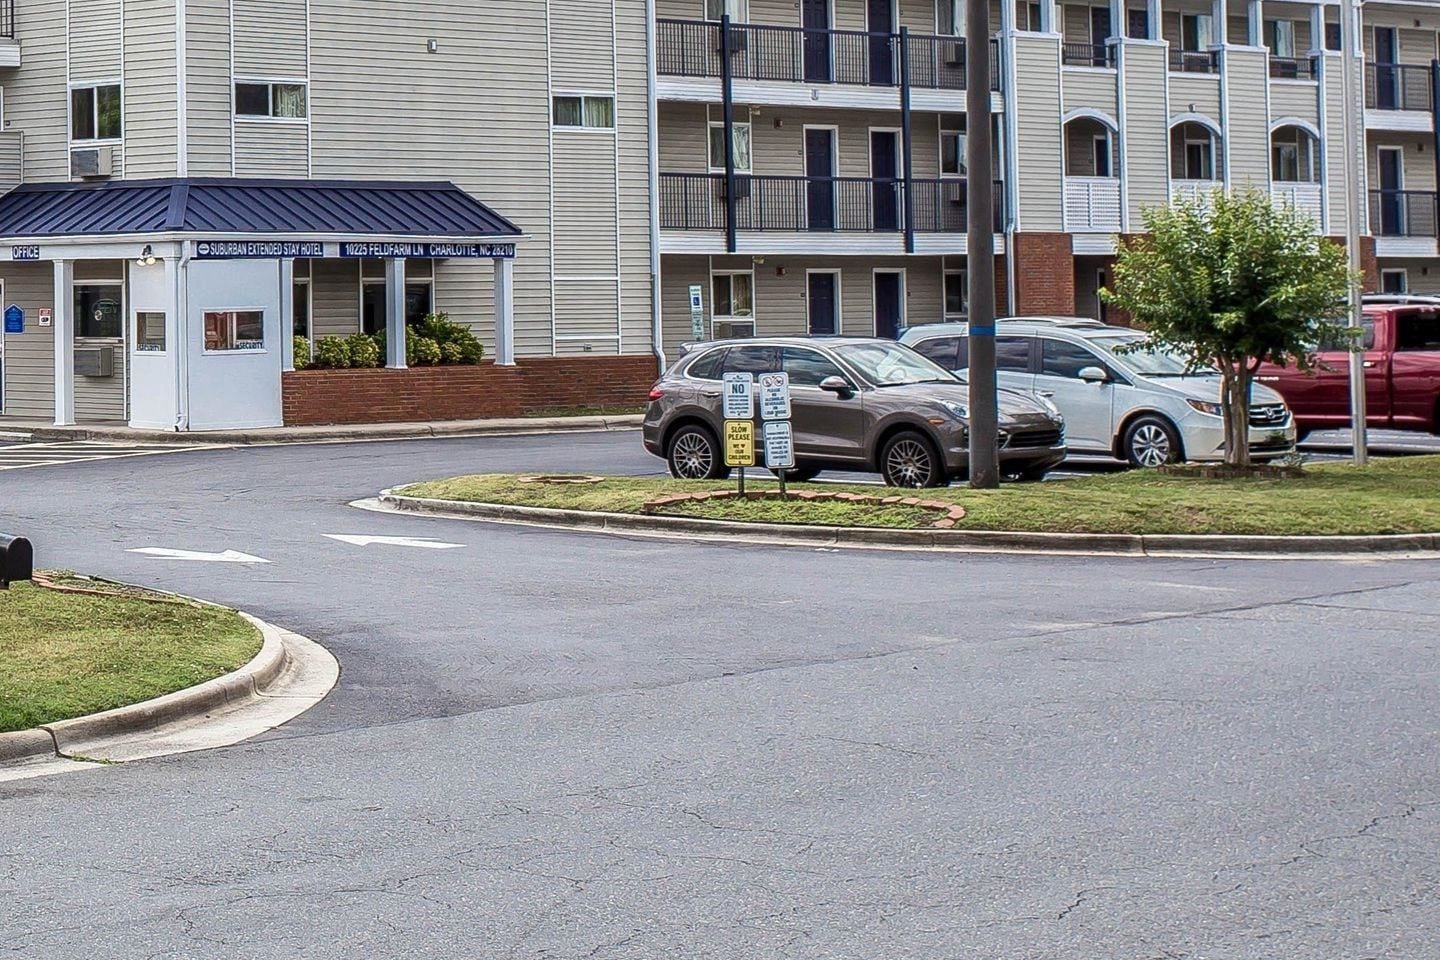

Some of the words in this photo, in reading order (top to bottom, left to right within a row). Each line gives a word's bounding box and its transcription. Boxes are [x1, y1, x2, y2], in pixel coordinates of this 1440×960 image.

[13, 246, 39, 258] OFFICE
[209, 242, 247, 256] SUBURBAN
[248, 242, 282, 256] EXTENDED
[283, 242, 300, 255] STAY
[301, 242, 323, 255] HOTEL
[345, 243, 367, 256] 10225
[369, 243, 410, 256] FELDFARM
[413, 243, 424, 256] LN
[479, 243, 491, 256] NC
[732, 384, 744, 394] NO
